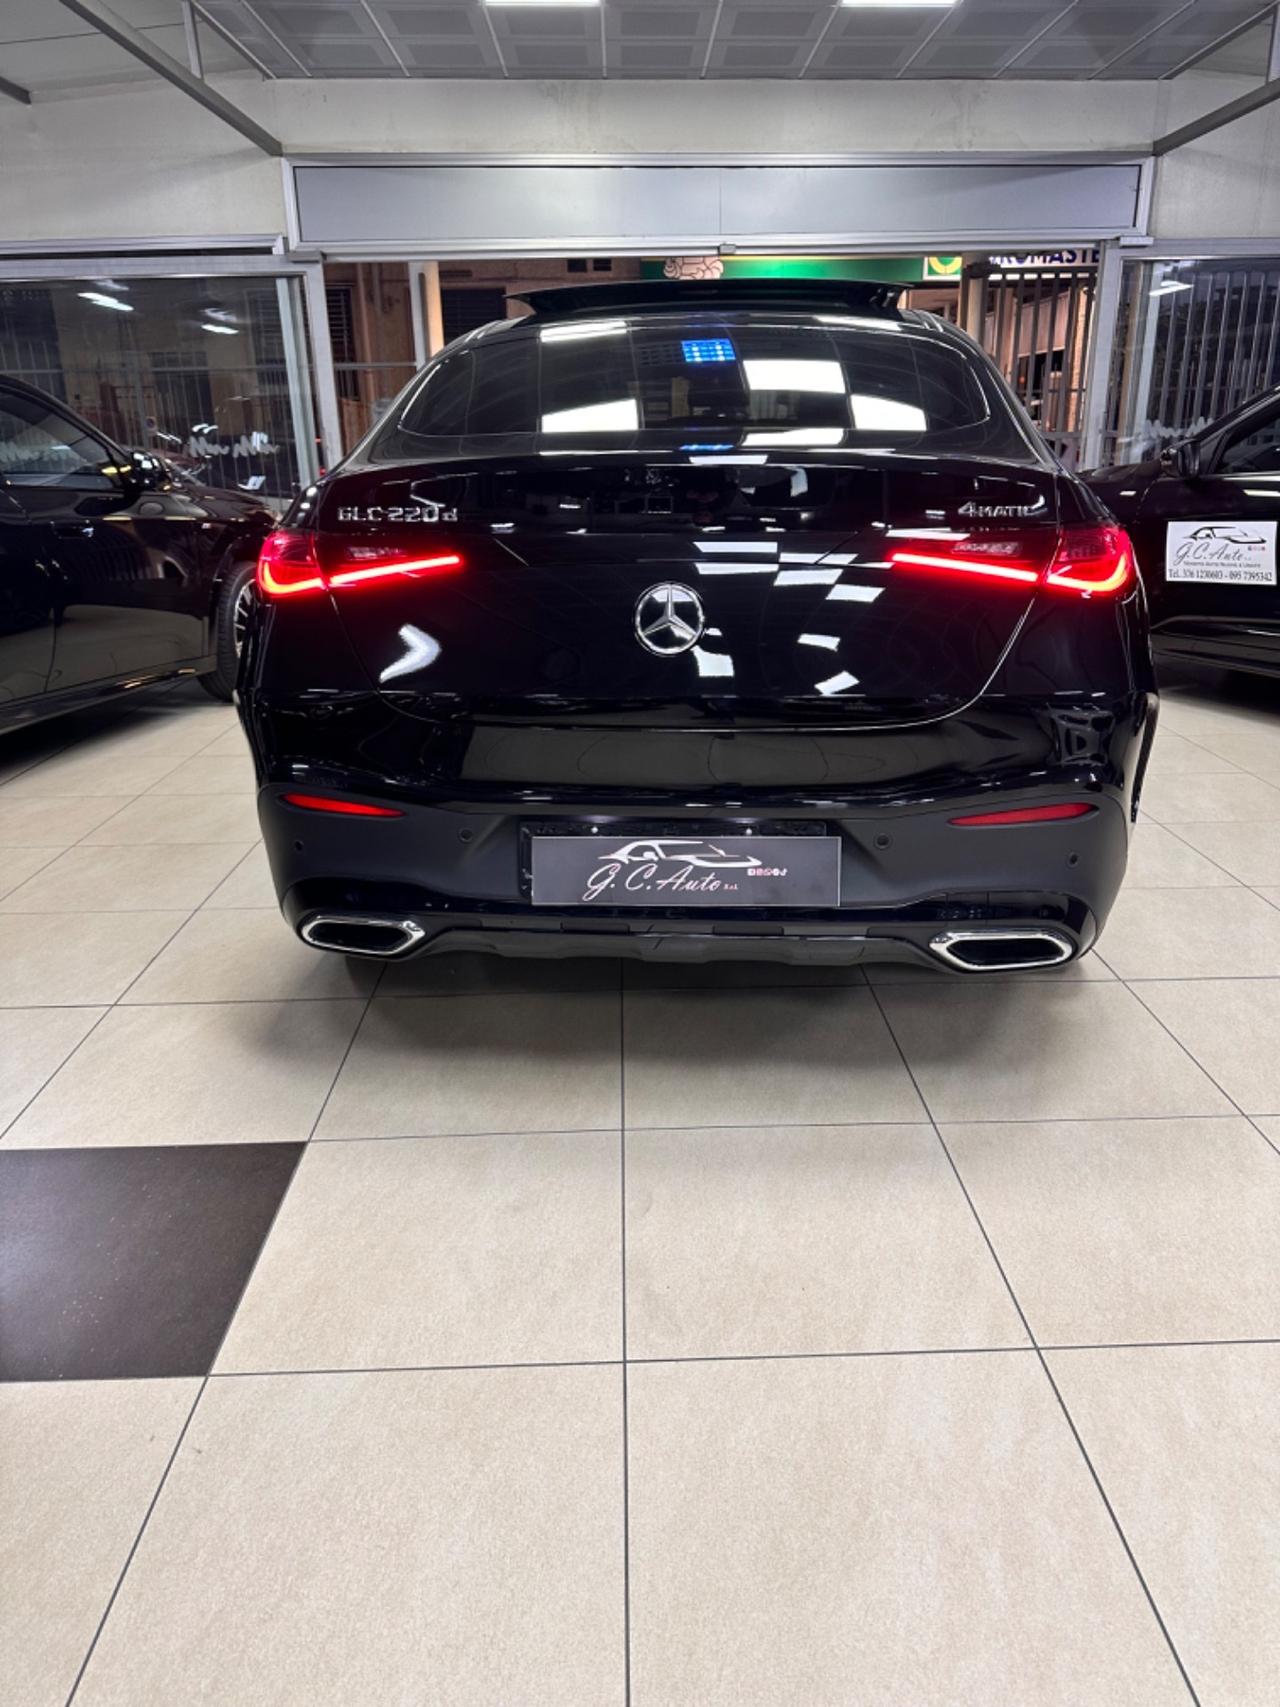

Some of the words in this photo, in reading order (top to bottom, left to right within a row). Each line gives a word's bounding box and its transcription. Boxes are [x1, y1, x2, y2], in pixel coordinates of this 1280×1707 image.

[337, 506, 382, 521] GLC
[387, 504, 440, 522] 220
[442, 507, 458, 521] d
[655, 864, 722, 892] Auto
